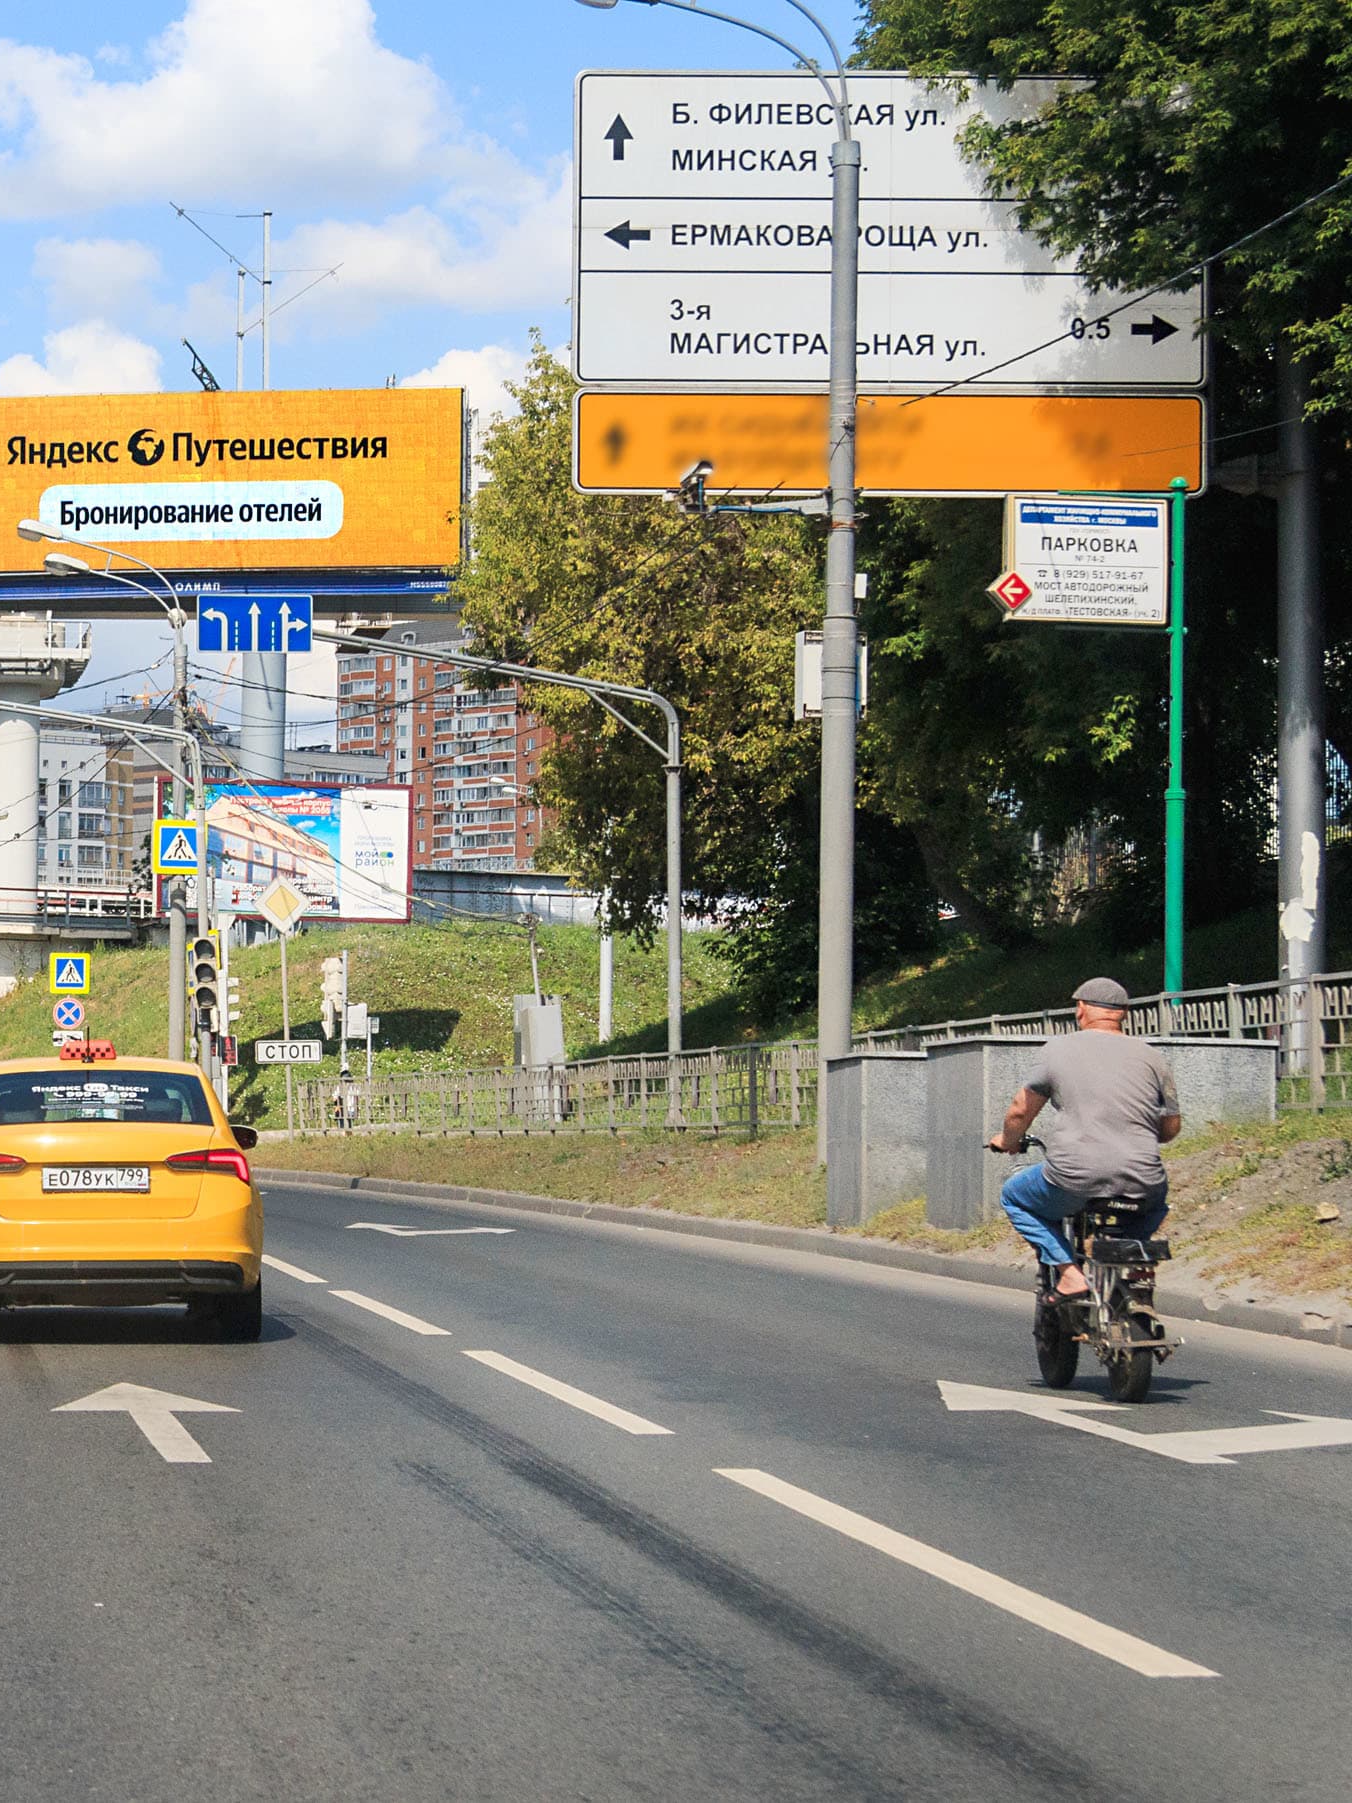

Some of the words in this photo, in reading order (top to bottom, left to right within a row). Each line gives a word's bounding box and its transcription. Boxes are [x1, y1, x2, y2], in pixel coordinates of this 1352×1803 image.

[671, 102, 698, 125] Б.
[905, 109, 946, 131] ул.
[671, 149, 818, 172] МИНСКАЯ
[670, 223, 832, 246] ЕРМАКОВА
[947, 230, 989, 253] ул.
[669, 298, 712, 321] 3-я
[1071, 317, 1111, 340] 0.5
[670, 332, 935, 356] МАГИСТРАЬНАЯ
[944, 339, 986, 361] ул.
[6, 435, 119, 468] Яндекс
[171, 431, 389, 467] Путешествия
[59, 500, 234, 531] Бронирование
[238, 496, 323, 523] отелей
[1041, 536, 1138, 553] ПАРКОВКА
[1053, 569, 1060, 578] 8
[174, 582, 221, 592] ОЛИМП
[1034, 581, 1062, 591] МОСТ
[1064, 582, 1149, 593] АВТОДОРОЖНЫЙ
[265, 1044, 313, 1060] СТОП
